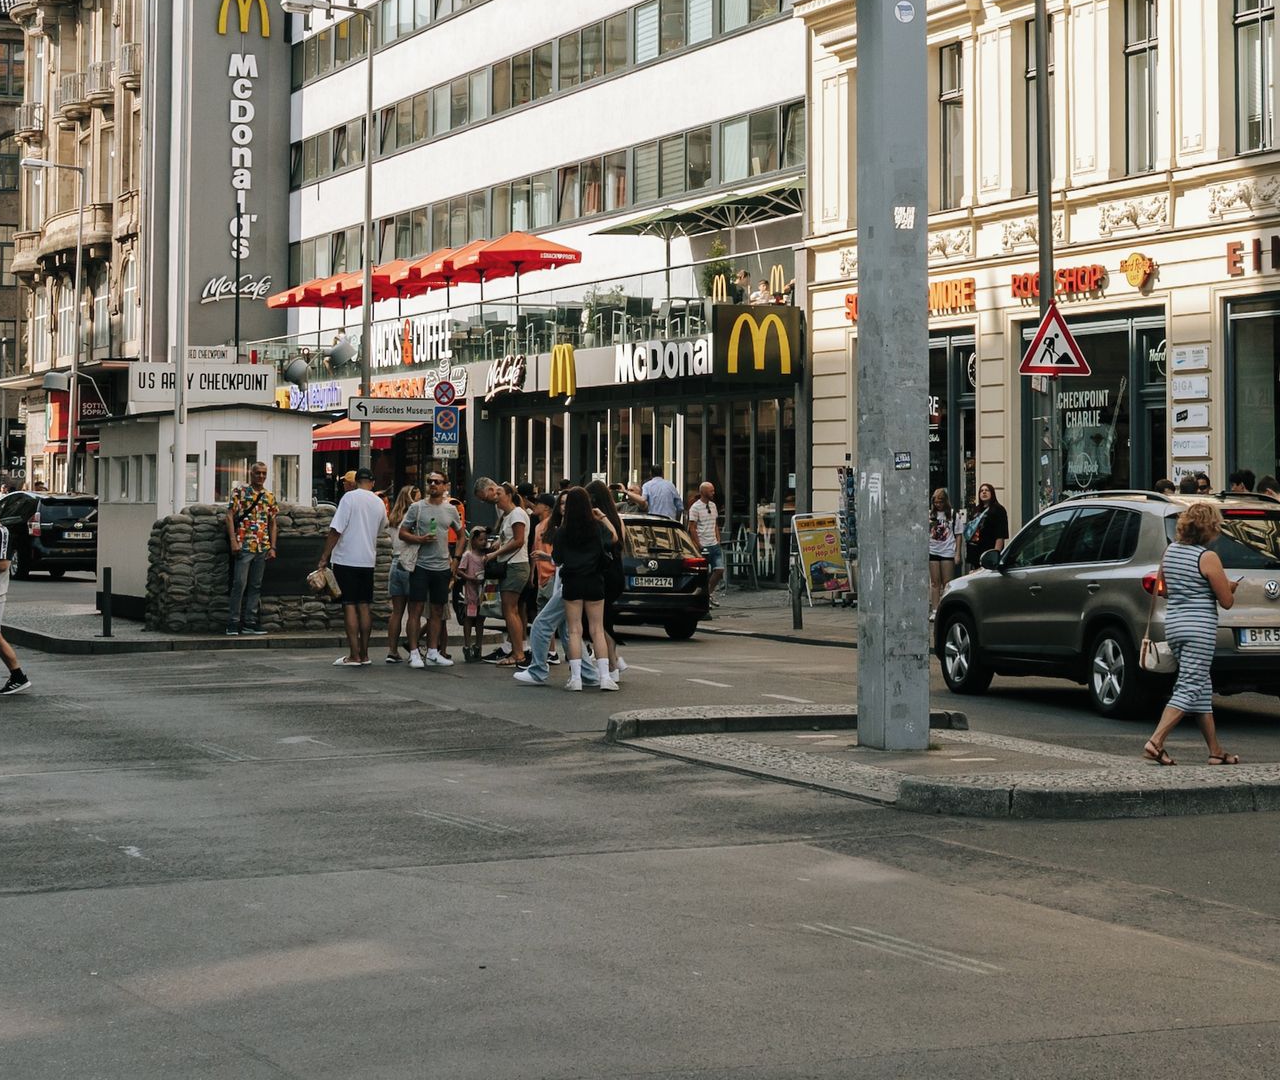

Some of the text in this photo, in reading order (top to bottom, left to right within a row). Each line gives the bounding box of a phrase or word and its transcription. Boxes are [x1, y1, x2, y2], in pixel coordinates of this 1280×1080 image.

[1012, 271, 1040, 298] ROC
[412, 312, 454, 363] COFFEE
[198, 350, 228, 360] CHECKPOINT
[615, 333, 713, 382] McDonal
[1149, 348, 1166, 362] Hard
[161, 373, 194, 390] ARY
[200, 373, 269, 391] CHECKPOINT
[1057, 390, 1109, 409] CHECKPOINT
[372, 405, 433, 415] Jüdisches Museum
[1066, 410, 1101, 428] CHARLIE
[437, 432, 457, 441] TAXI
[1173, 440, 1191, 449] PIVOT
[1250, 630, 1258, 641] B
